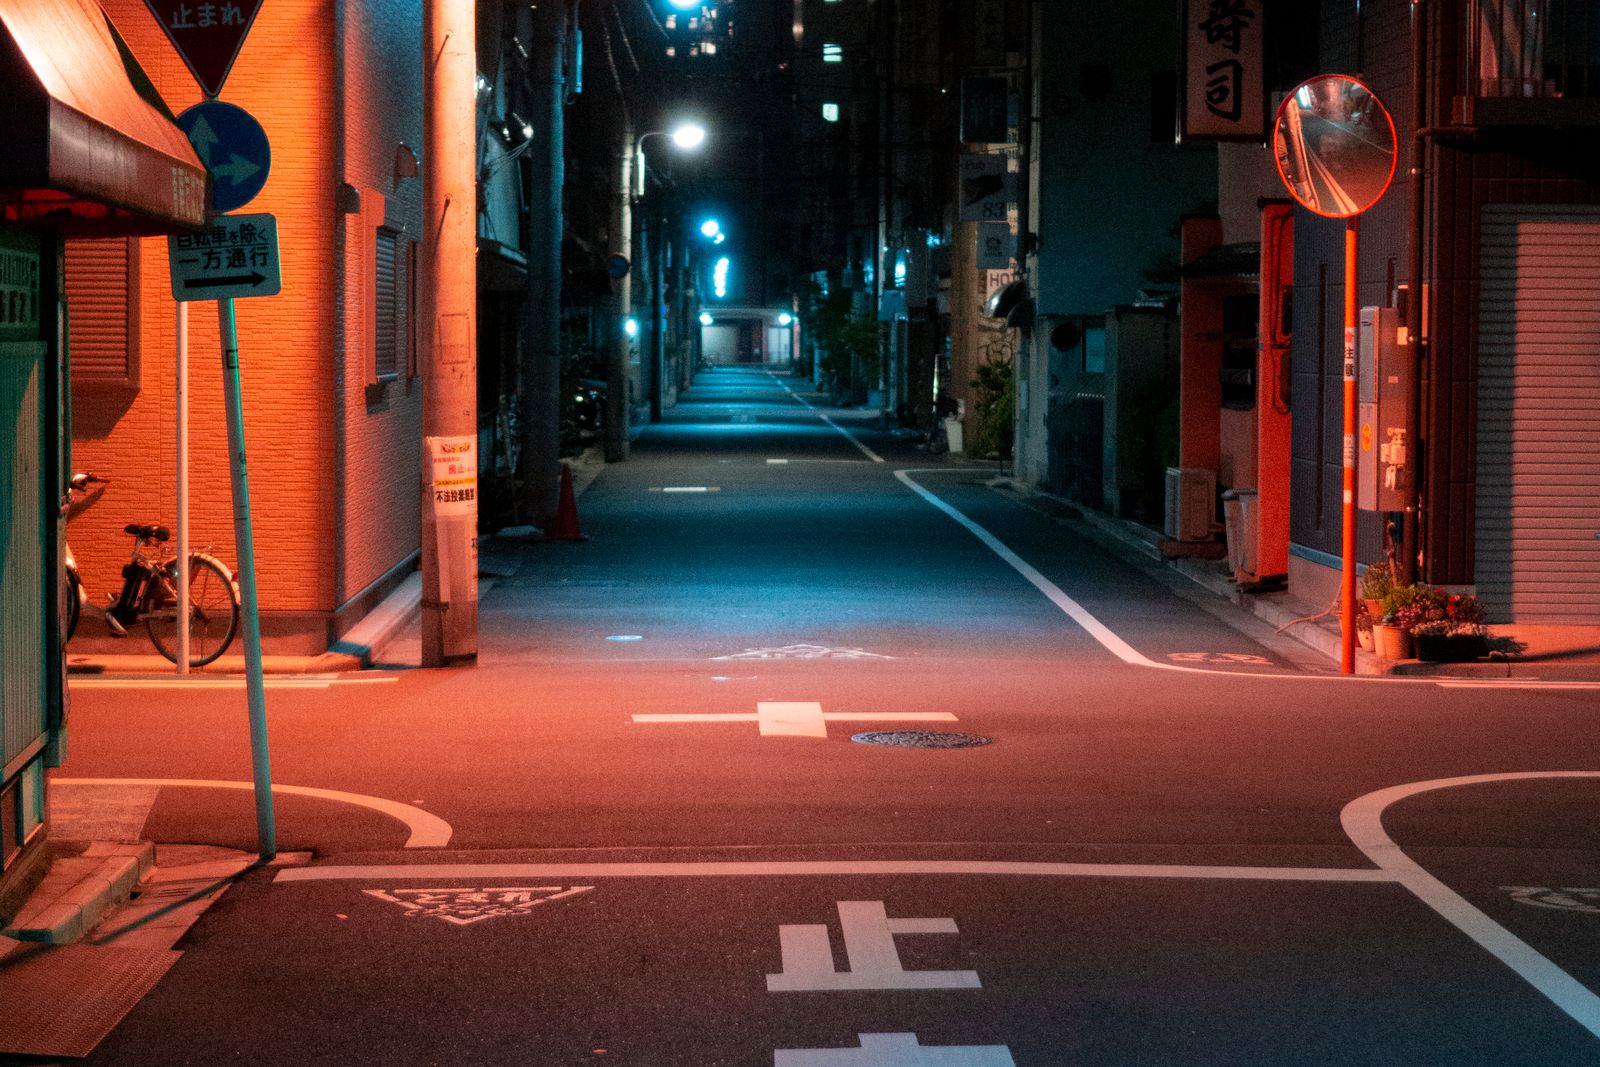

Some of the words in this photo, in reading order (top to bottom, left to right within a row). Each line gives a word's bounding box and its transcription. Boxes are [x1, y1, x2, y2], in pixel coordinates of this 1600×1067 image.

[170, 1, 245, 28] 止まれ
[982, 201, 1004, 218] 83
[178, 246, 269, 270] 一方通行
